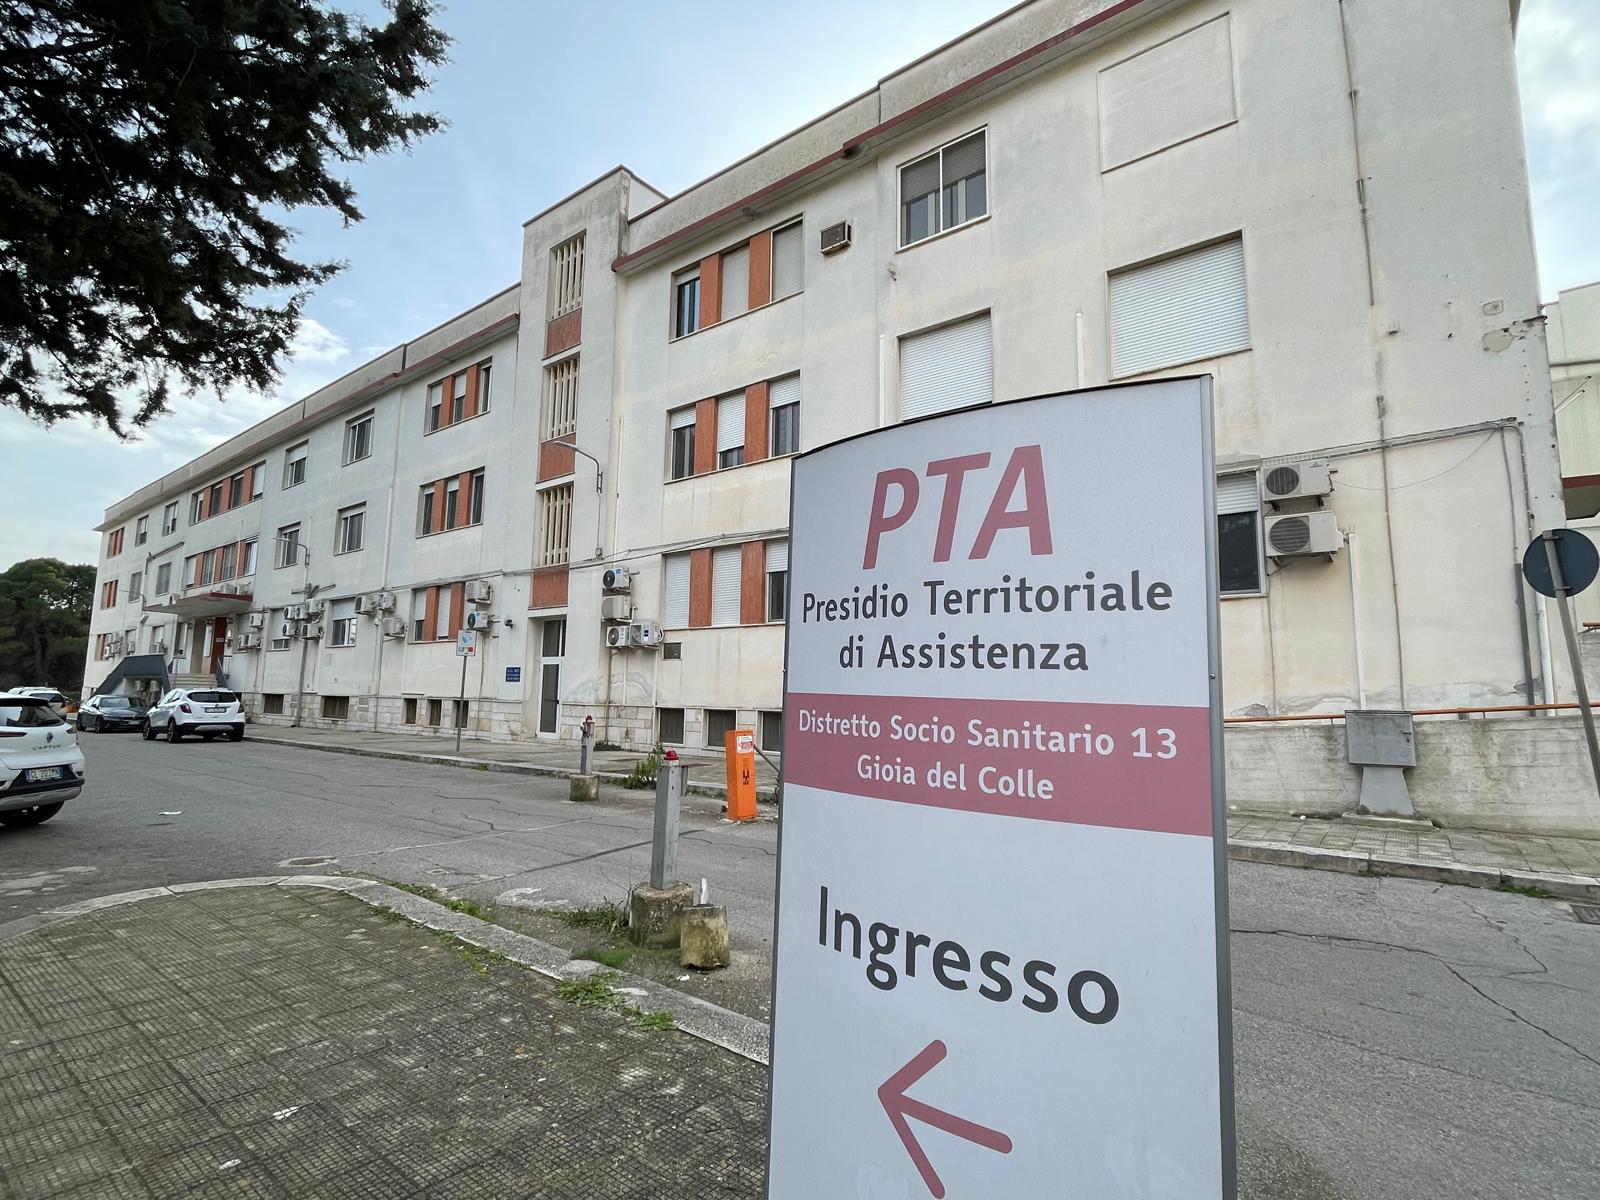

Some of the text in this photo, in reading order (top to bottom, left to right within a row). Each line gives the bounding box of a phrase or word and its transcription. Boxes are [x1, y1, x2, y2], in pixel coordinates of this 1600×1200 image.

[862, 444, 1053, 570] PTA
[802, 570, 1173, 624] Presidio Territoriale
[839, 632, 1089, 671] di Assistenza
[799, 709, 1177, 759] Distretto Socio Sanitario 13
[857, 754, 1054, 800] Gioia del Colle
[818, 885, 1120, 1025] Ingresso
